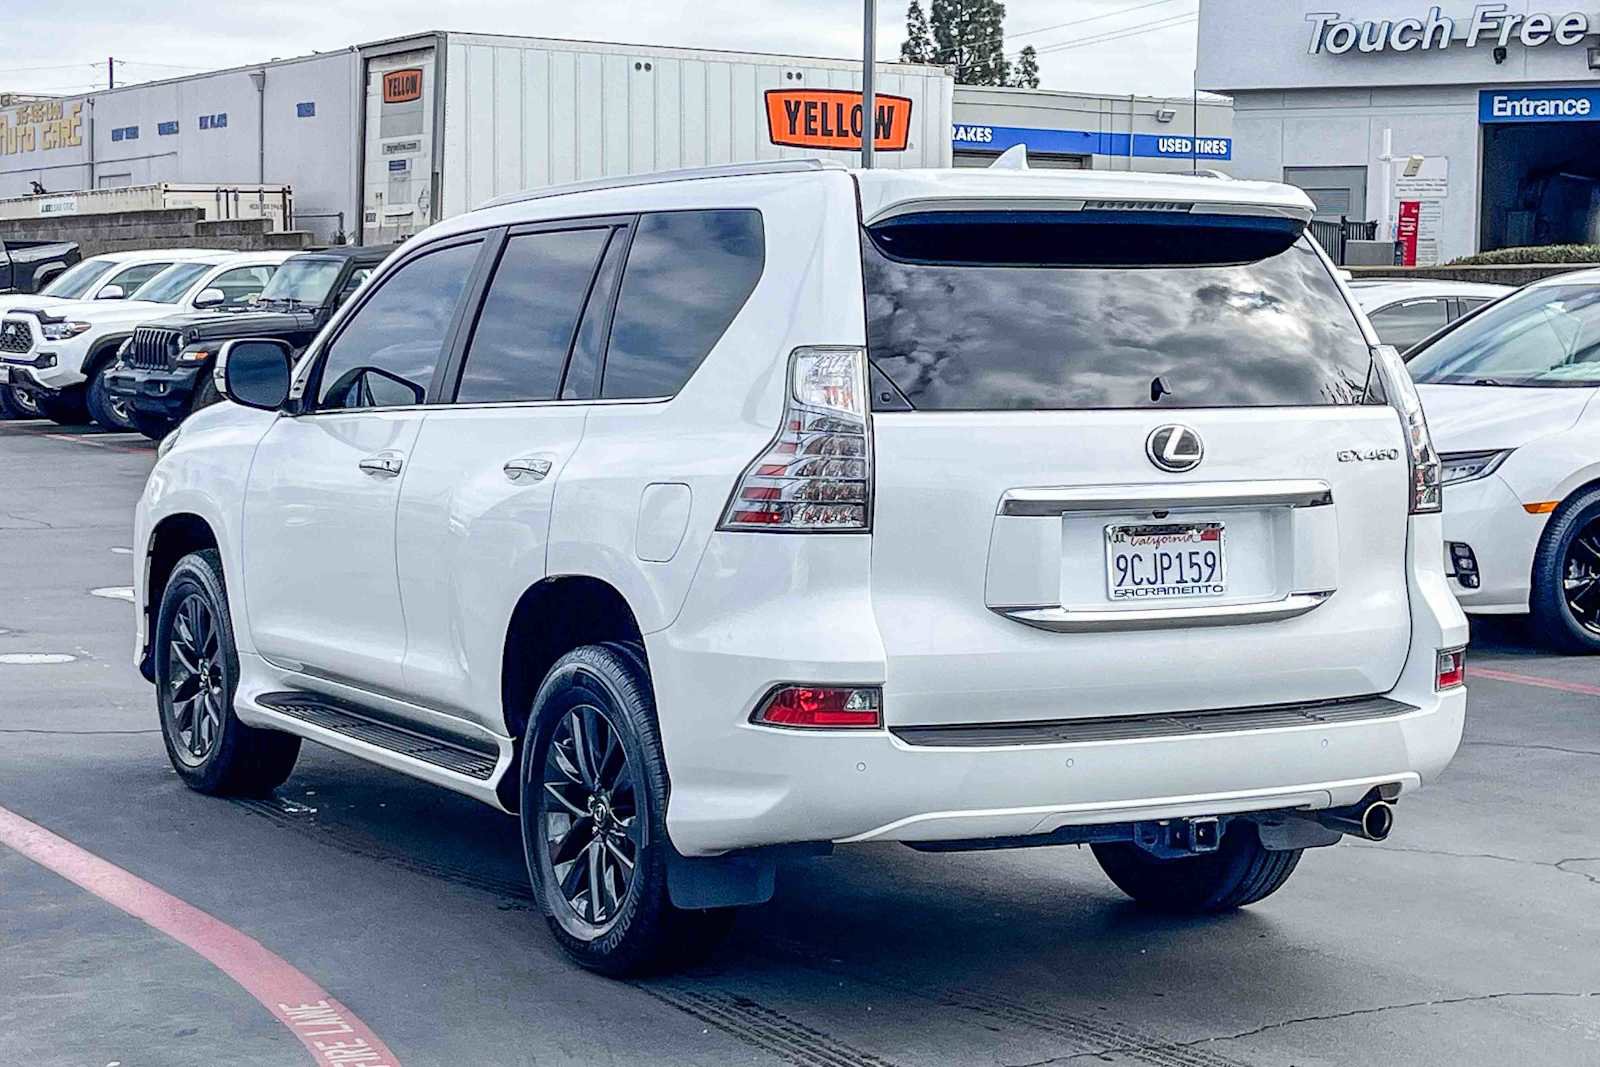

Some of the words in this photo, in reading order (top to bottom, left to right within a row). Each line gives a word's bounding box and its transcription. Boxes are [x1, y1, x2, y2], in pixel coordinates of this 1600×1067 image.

[1305, 7, 1455, 56] Touch
[1465, 4, 1588, 48] Free
[384, 75, 418, 98] YELLOW
[784, 99, 896, 140] YELLOW
[1492, 95, 1590, 117] Entrance
[1158, 138, 1192, 153] USED
[1194, 139, 1228, 155] TIRES
[1116, 550, 1216, 587] 9CJP159
[1114, 584, 1224, 598] SACRAMENTO
[278, 1000, 354, 1036] LANE
